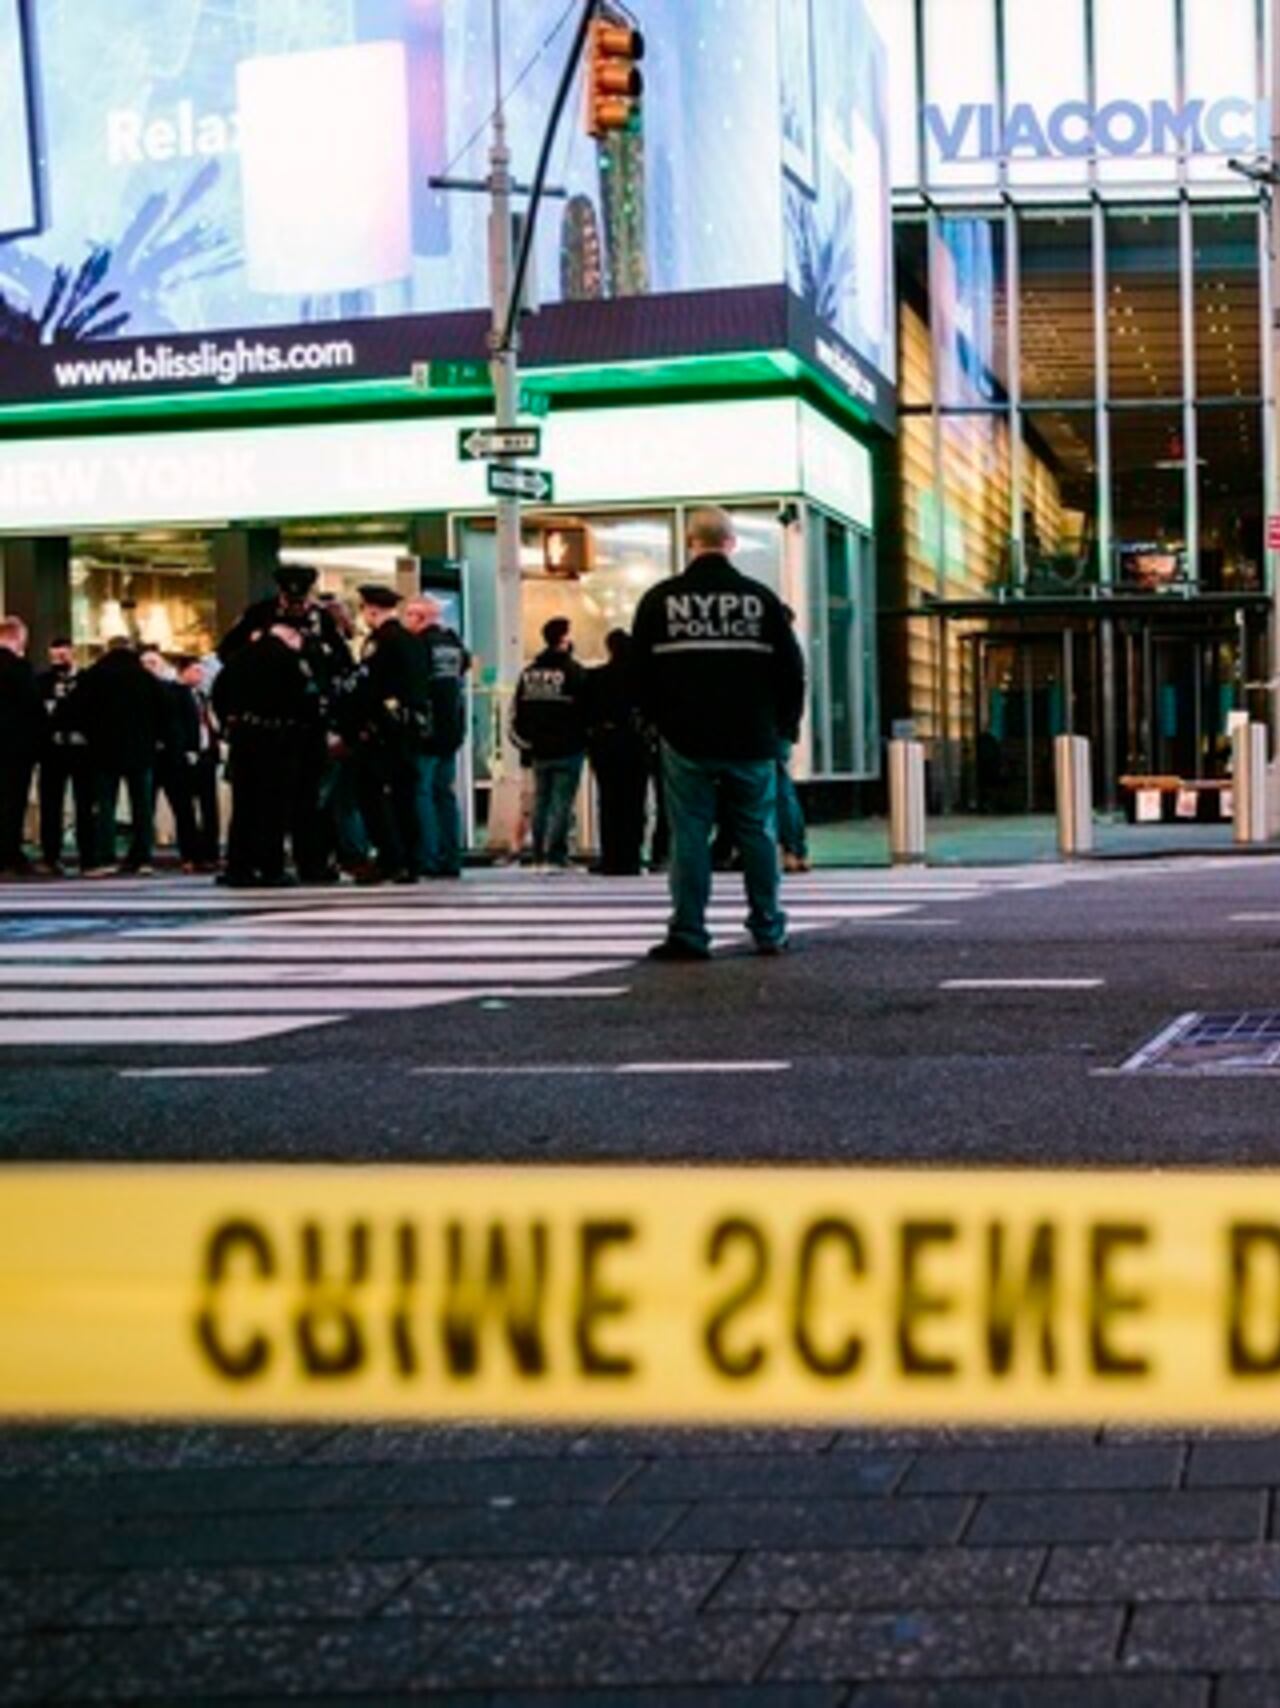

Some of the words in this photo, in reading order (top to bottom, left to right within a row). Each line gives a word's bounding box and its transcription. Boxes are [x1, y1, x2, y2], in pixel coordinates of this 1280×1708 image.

[55, 339, 354, 385] www.blisslights.com
[113, 450, 256, 500] YORK
[666, 595, 765, 619] NYPD
[668, 618, 761, 638] POLICE
